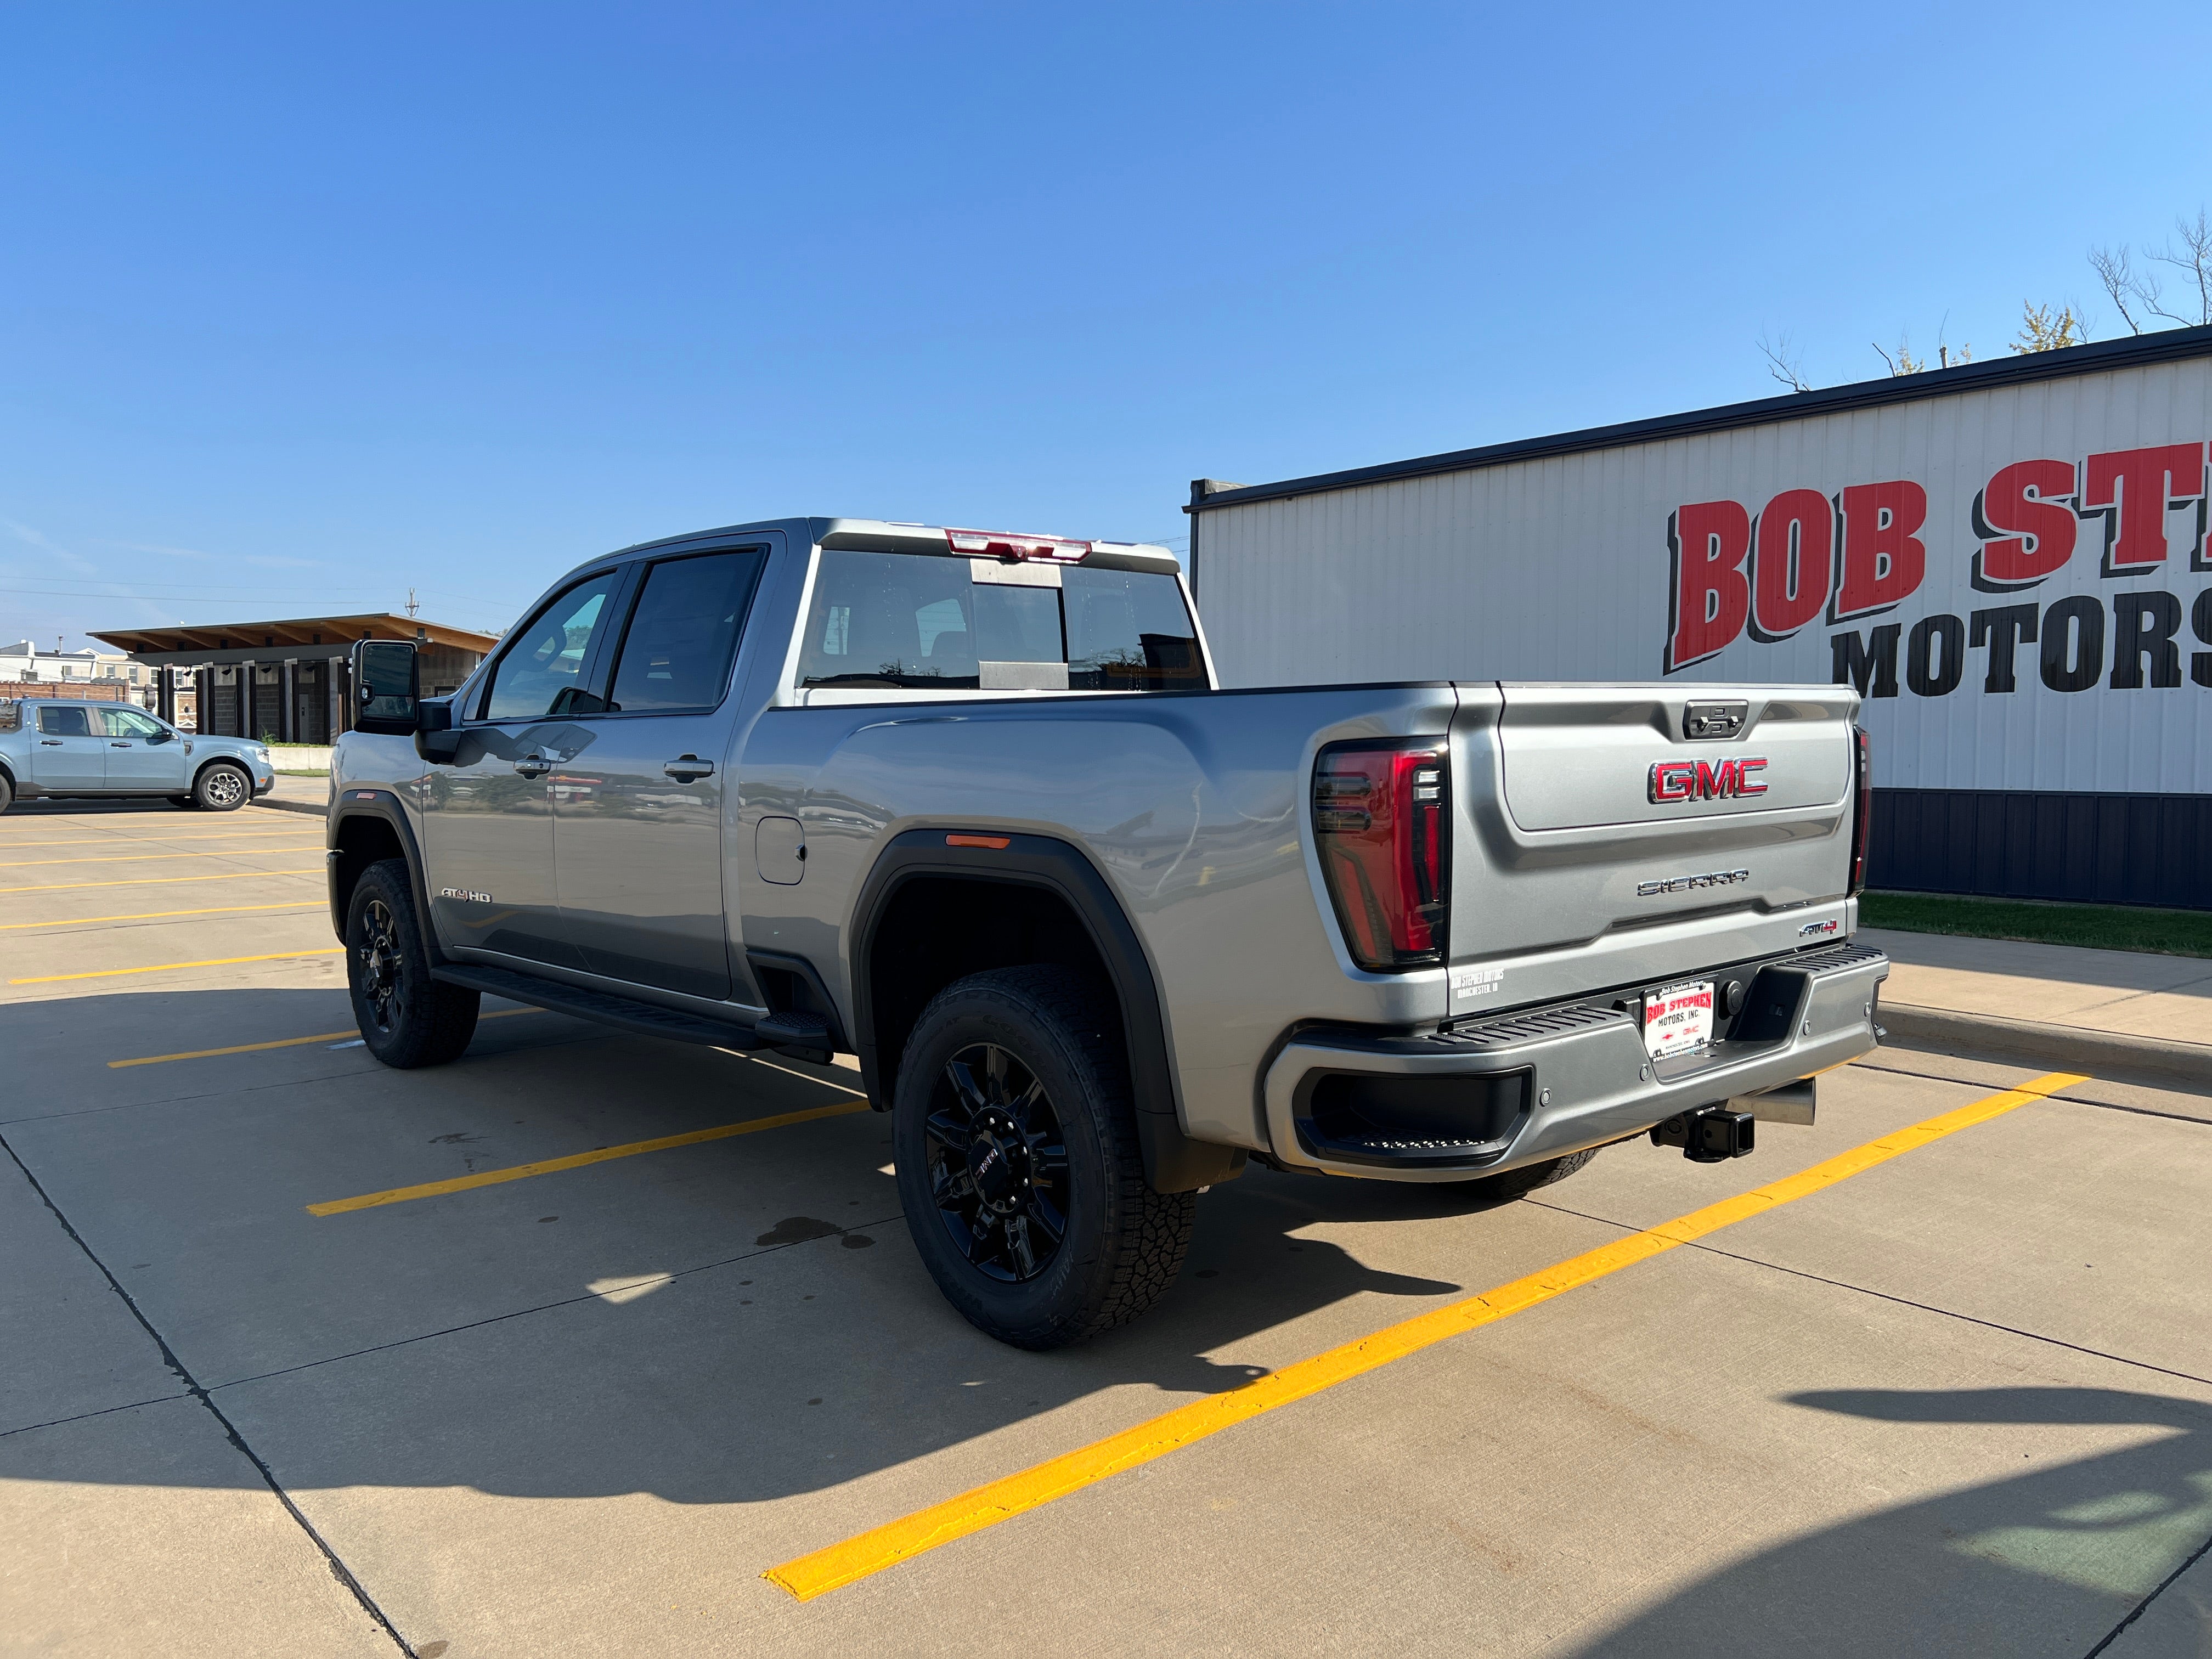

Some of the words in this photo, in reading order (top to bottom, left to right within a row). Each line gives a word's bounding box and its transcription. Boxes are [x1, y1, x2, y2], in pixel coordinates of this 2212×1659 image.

[1663, 479, 1927, 676] BOB
[1971, 441, 2212, 593] ST
[1648, 757, 1769, 805] GMC
[1637, 868, 1750, 897] SIERRA
[1799, 918, 1837, 938] AT4
[1462, 972, 1483, 988] STEPHEN
[1483, 968, 1504, 983] MOTORS
[1671, 983, 1689, 994] Stephen
[1689, 980, 1704, 989] Motors
[1645, 1002, 1666, 1026] BOB
[1669, 991, 1712, 1012] STEPHEN
[1658, 1012, 1686, 1027] MOTORS,
[1688, 1009, 1701, 1020] INC.
[1683, 1025, 1699, 1035] GMC
[975, 1148, 998, 1180] GMC
